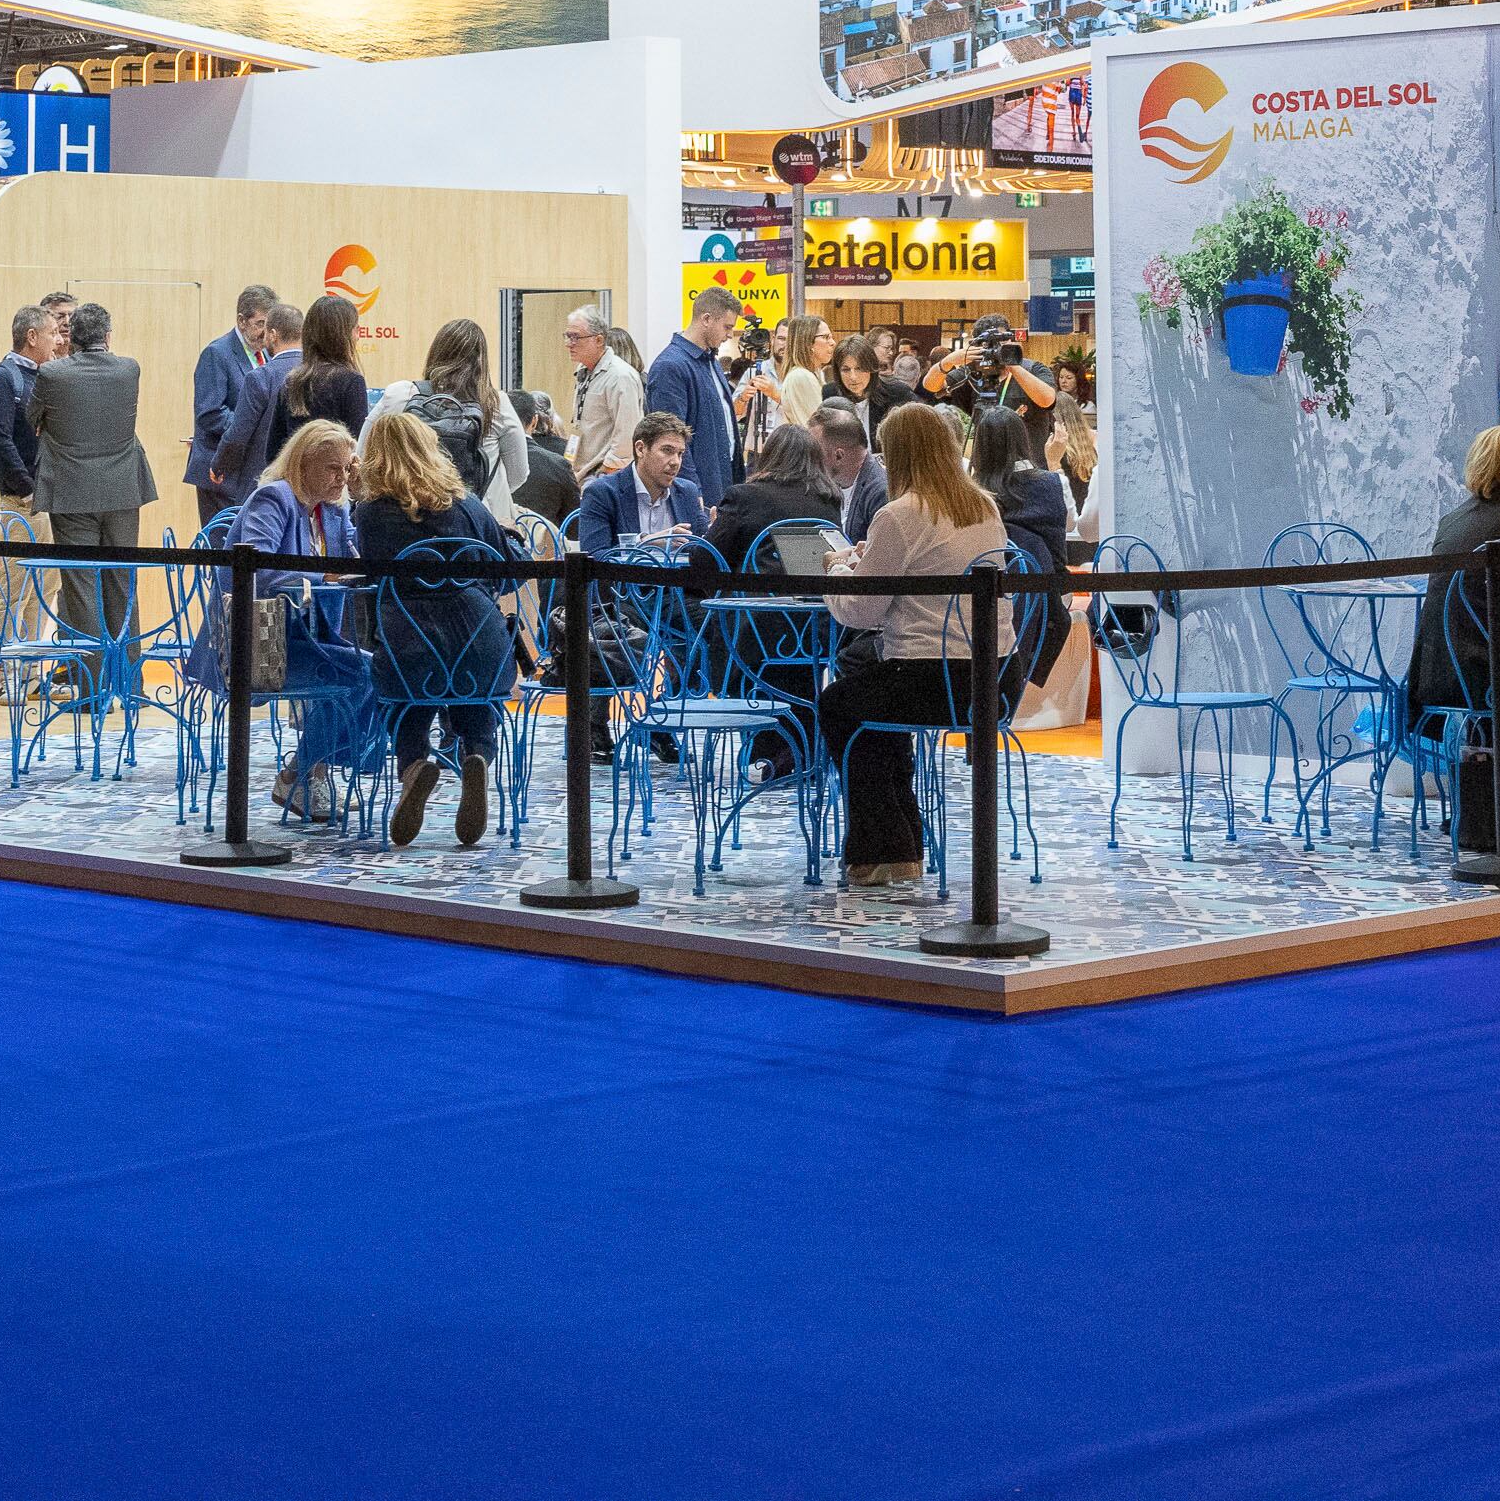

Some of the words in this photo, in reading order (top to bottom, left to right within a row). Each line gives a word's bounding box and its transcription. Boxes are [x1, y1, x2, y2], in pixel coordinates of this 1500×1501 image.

[1252, 89, 1330, 115] COSTA
[1336, 86, 1382, 110] DEL
[1387, 82, 1438, 106] SOL
[1253, 115, 1354, 143] MÁLAGA
[790, 151, 814, 162] wtm
[689, 289, 780, 300] CUNYA
[358, 327, 373, 338] EL
[375, 327, 400, 339] SOL
